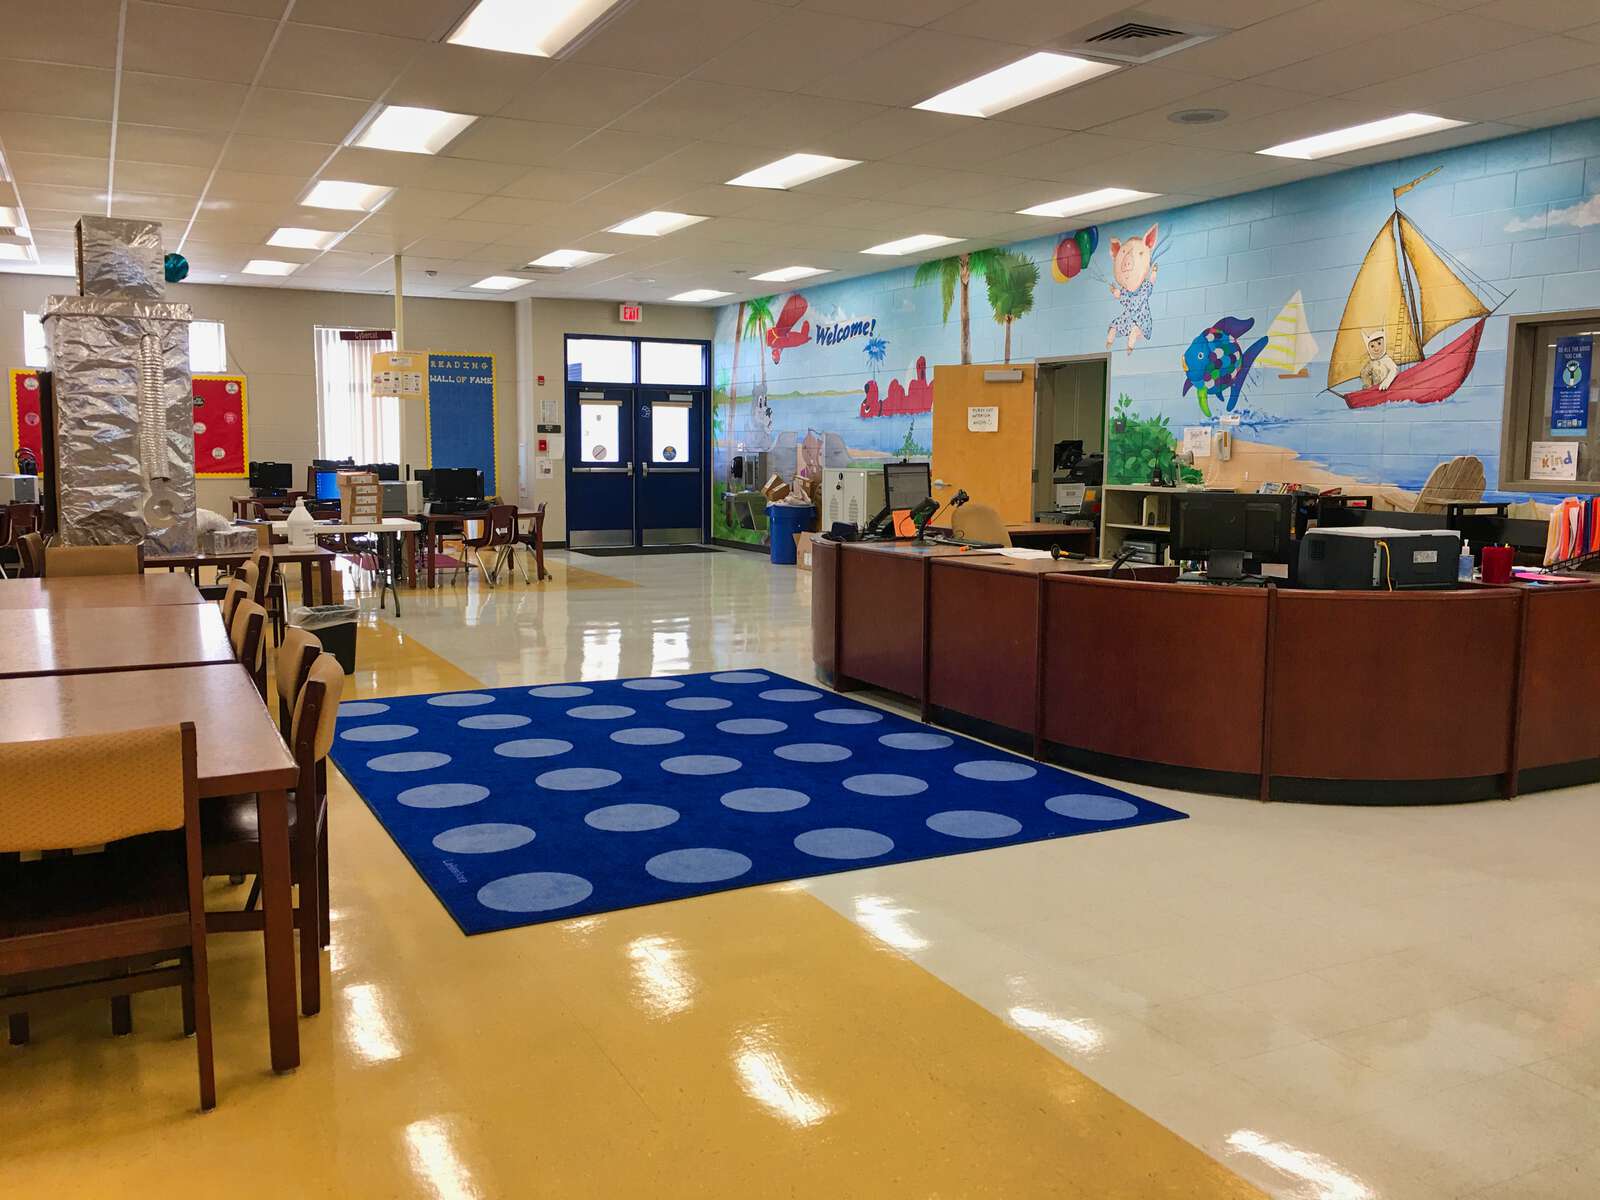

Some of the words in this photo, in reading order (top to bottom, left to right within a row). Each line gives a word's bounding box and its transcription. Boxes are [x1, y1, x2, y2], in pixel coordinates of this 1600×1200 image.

[624, 306, 639, 320] EXIT
[816, 319, 876, 346] Welcome!
[431, 360, 488, 369] READING
[430, 375, 455, 383] WALL
[456, 376, 467, 384] OF
[469, 376, 493, 384] FAME
[1541, 450, 1573, 469] kind
